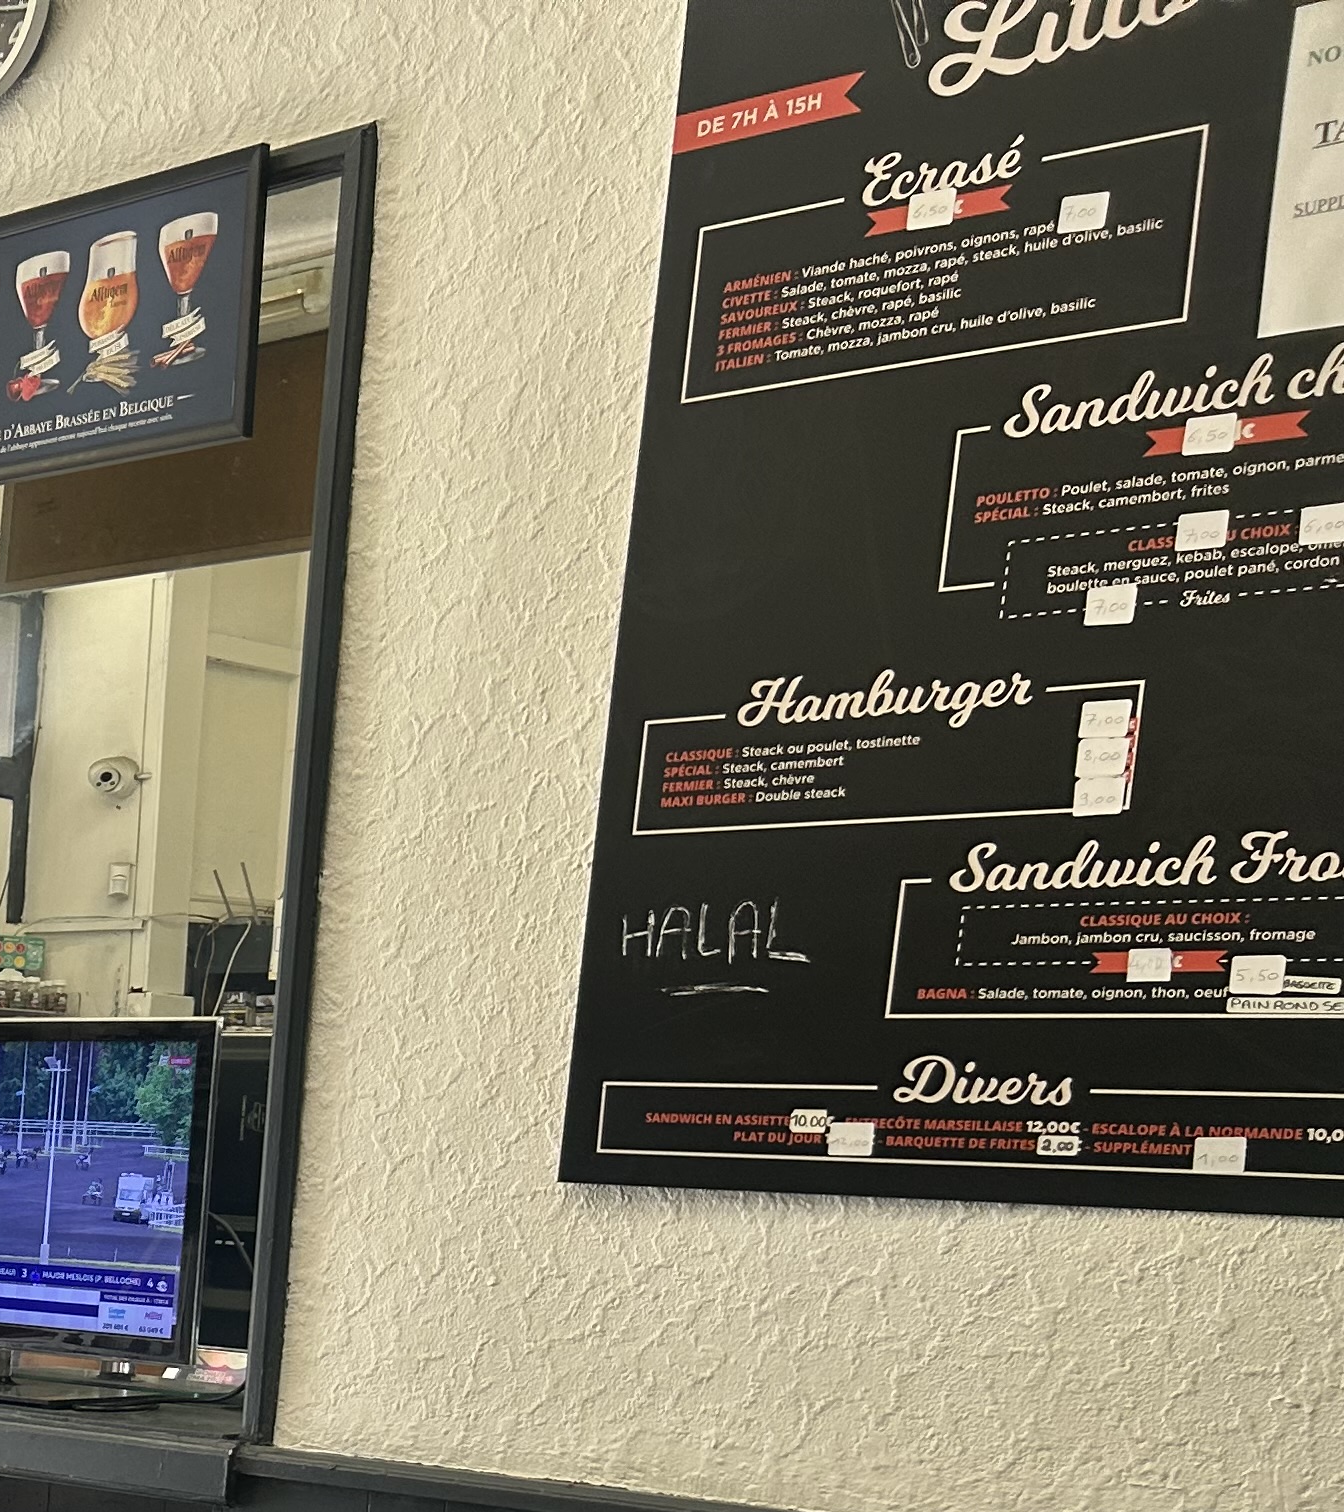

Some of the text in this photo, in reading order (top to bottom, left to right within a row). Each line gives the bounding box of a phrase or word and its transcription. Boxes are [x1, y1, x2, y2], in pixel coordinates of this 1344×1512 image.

[8, 20, 24, 45] 4
[696, 92, 823, 138] DE 7H À 15H
[862, 135, 1025, 207] Ecrasé
[722, 217, 1164, 310] CIVETTE Salade, tomate, mozza, rapé, steack, huile basilic
[723, 220, 1055, 293] ARMÉNIEN Viande haché, poivrons, oignons, rapé
[720, 270, 959, 325] SAVOUREUX Steack, roquefort, rapé
[715, 353, 764, 373] ITALIEN
[774, 343, 824, 362] Tomate,
[827, 336, 874, 353] mozza,
[876, 326, 928, 347] jambon
[931, 319, 957, 336] cru,
[960, 311, 994, 330] huile
[1050, 296, 1097, 316] basilic
[1003, 352, 1274, 438] Sandwich
[975, 457, 1291, 508] POULETTO Poulet, salade, tomate, oignon,
[974, 481, 1230, 525] SPÉCIAL Steack, camembert, frites
[1241, 523, 1290, 541] CHOIX
[1047, 561, 1100, 580] Steack,
[1103, 555, 1172, 575] merguez,
[1175, 549, 1226, 566] kebab,
[1230, 541, 1303, 560] escalope,
[1184, 565, 1234, 584] poulet
[1237, 560, 1280, 578] pané,
[1284, 554, 1340, 572] cordon
[736, 668, 1034, 729] Hamburger
[665, 733, 921, 765] CLASSIQUE Steack ou poulet, tostinette
[661, 785, 846, 808] MAXI BURGER Double steack
[949, 834, 1217, 892] Sandwich
[620, 896, 811, 965] HALAL
[1080, 911, 1242, 927] CLASSIQUE AU CHOIX
[1010, 926, 1316, 946] Jambon, jambon cru, saucisson, fromage
[916, 985, 1229, 1002] BAGNA Salade, tomate, oignon, thon, oeuf
[1231, 997, 1319, 1012] PAIN ROND
[893, 1055, 1073, 1106] Divers
[645, 1111, 791, 1127] SANDWICH EN ASSIETTE
[924, 1118, 1081, 1134] MARSEILLAISE 12,00€
[1091, 1121, 1303, 1141] ESCALOPE À LA NORMANDE
[733, 1131, 823, 1146] PLAT DU JOUR
[885, 1136, 1036, 1151] BARQUETTE DE FRITES
[1094, 1140, 1193, 1157] SUPPLÉMENT
